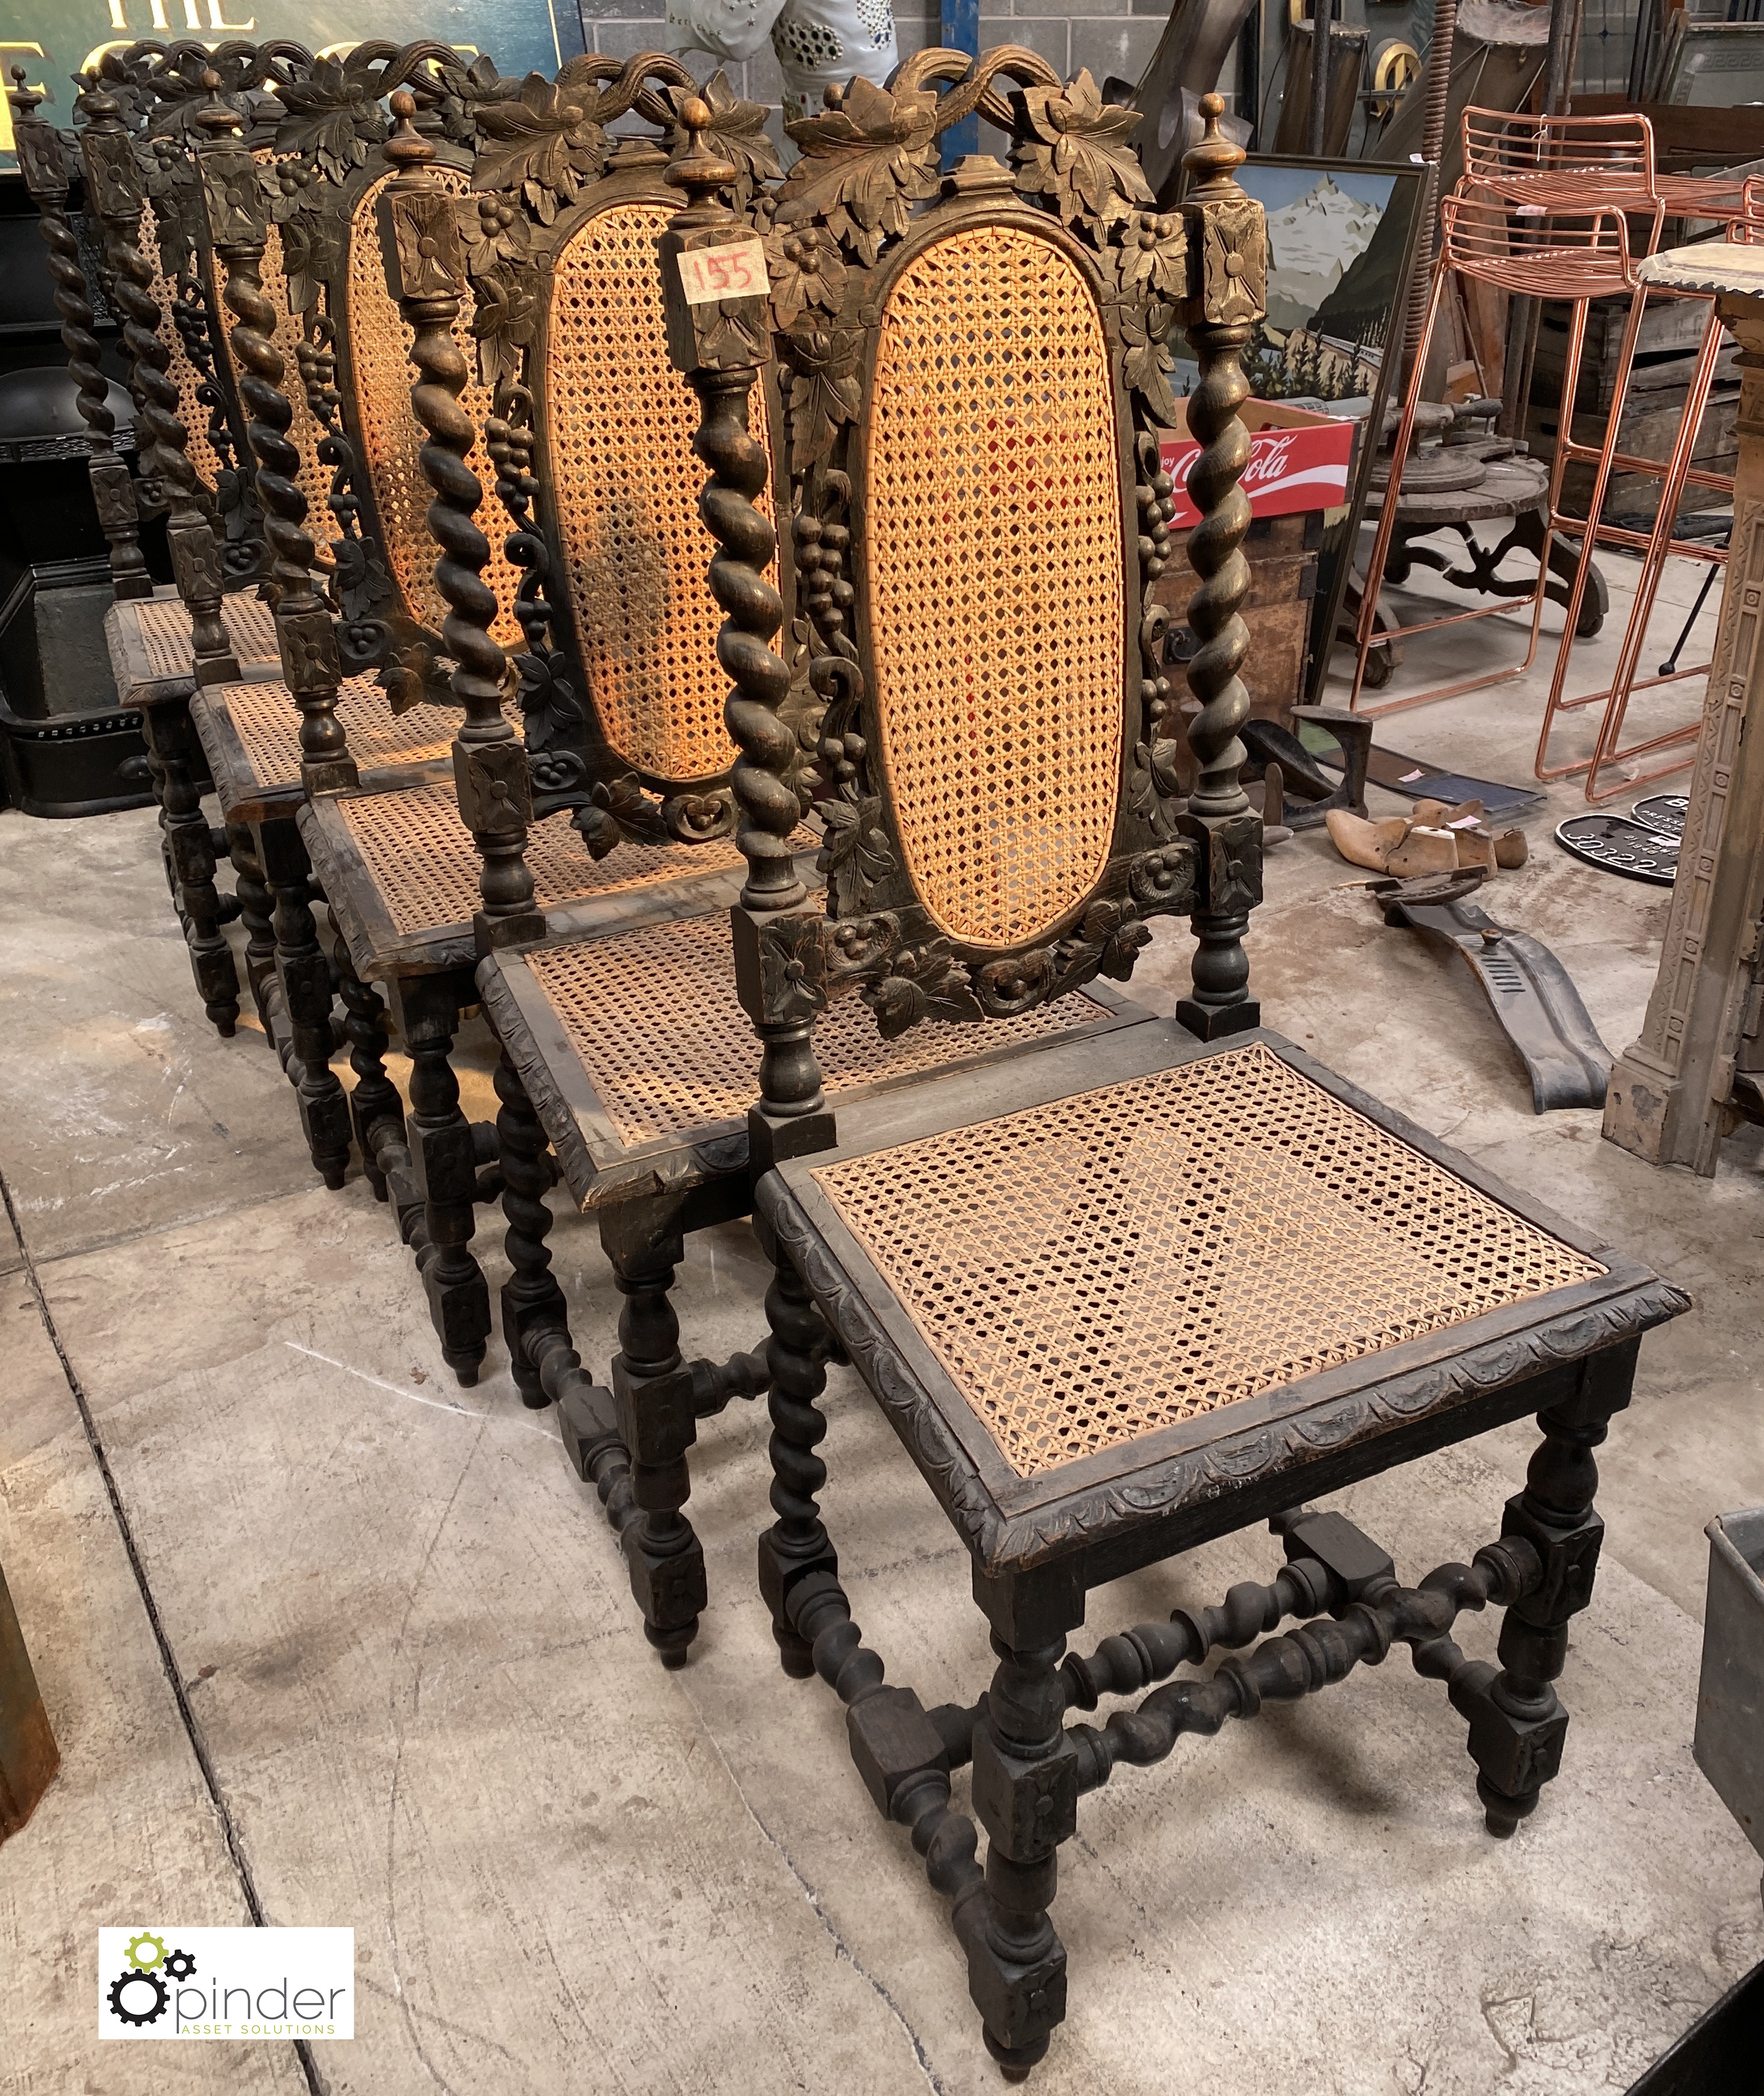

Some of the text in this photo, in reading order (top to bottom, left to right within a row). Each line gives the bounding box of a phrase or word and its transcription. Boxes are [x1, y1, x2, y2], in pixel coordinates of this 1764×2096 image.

[693, 251, 752, 291] 155
[1160, 456, 1175, 468] joy
[1645, 843, 1680, 856] TONS
